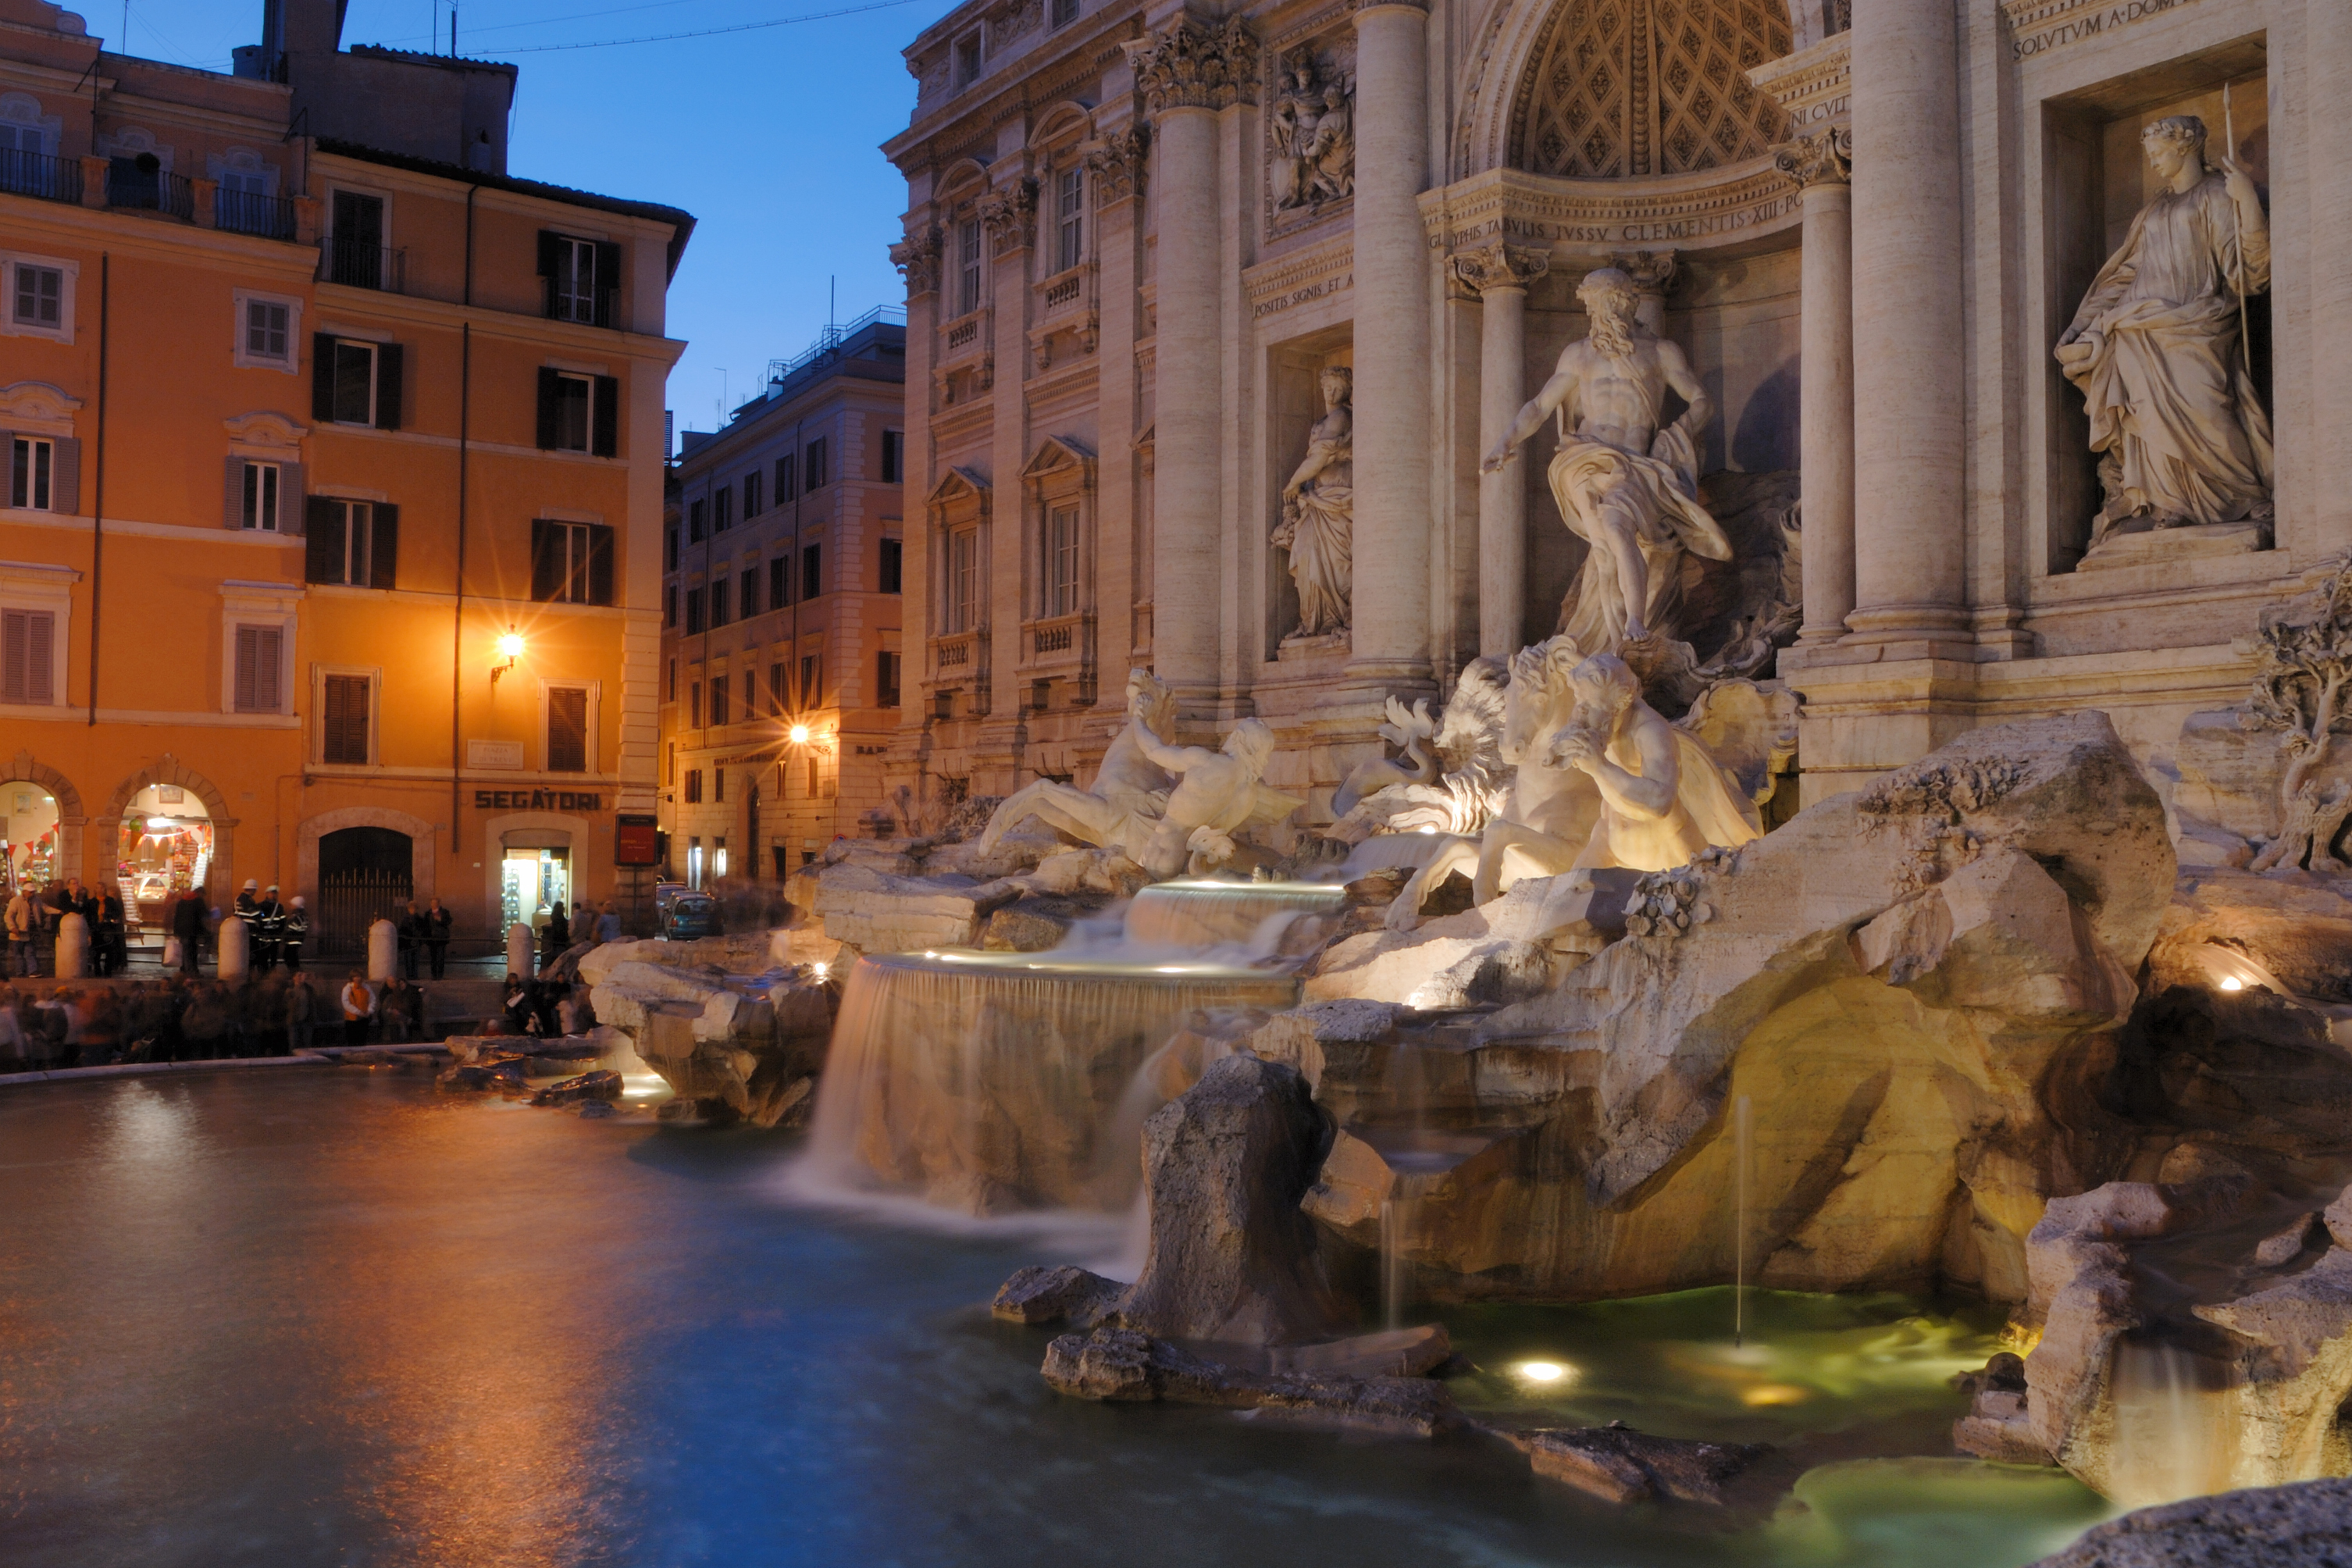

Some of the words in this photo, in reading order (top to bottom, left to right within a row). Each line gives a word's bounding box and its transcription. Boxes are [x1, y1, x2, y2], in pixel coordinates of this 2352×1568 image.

[2013, 13, 2102, 61] SOLVTVM
[1253, 294, 1288, 319] POSITIS
[1292, 283, 1323, 305] SIGNIS
[1327, 276, 1341, 294] ET
[475, 789, 602, 811] SEGATORI
